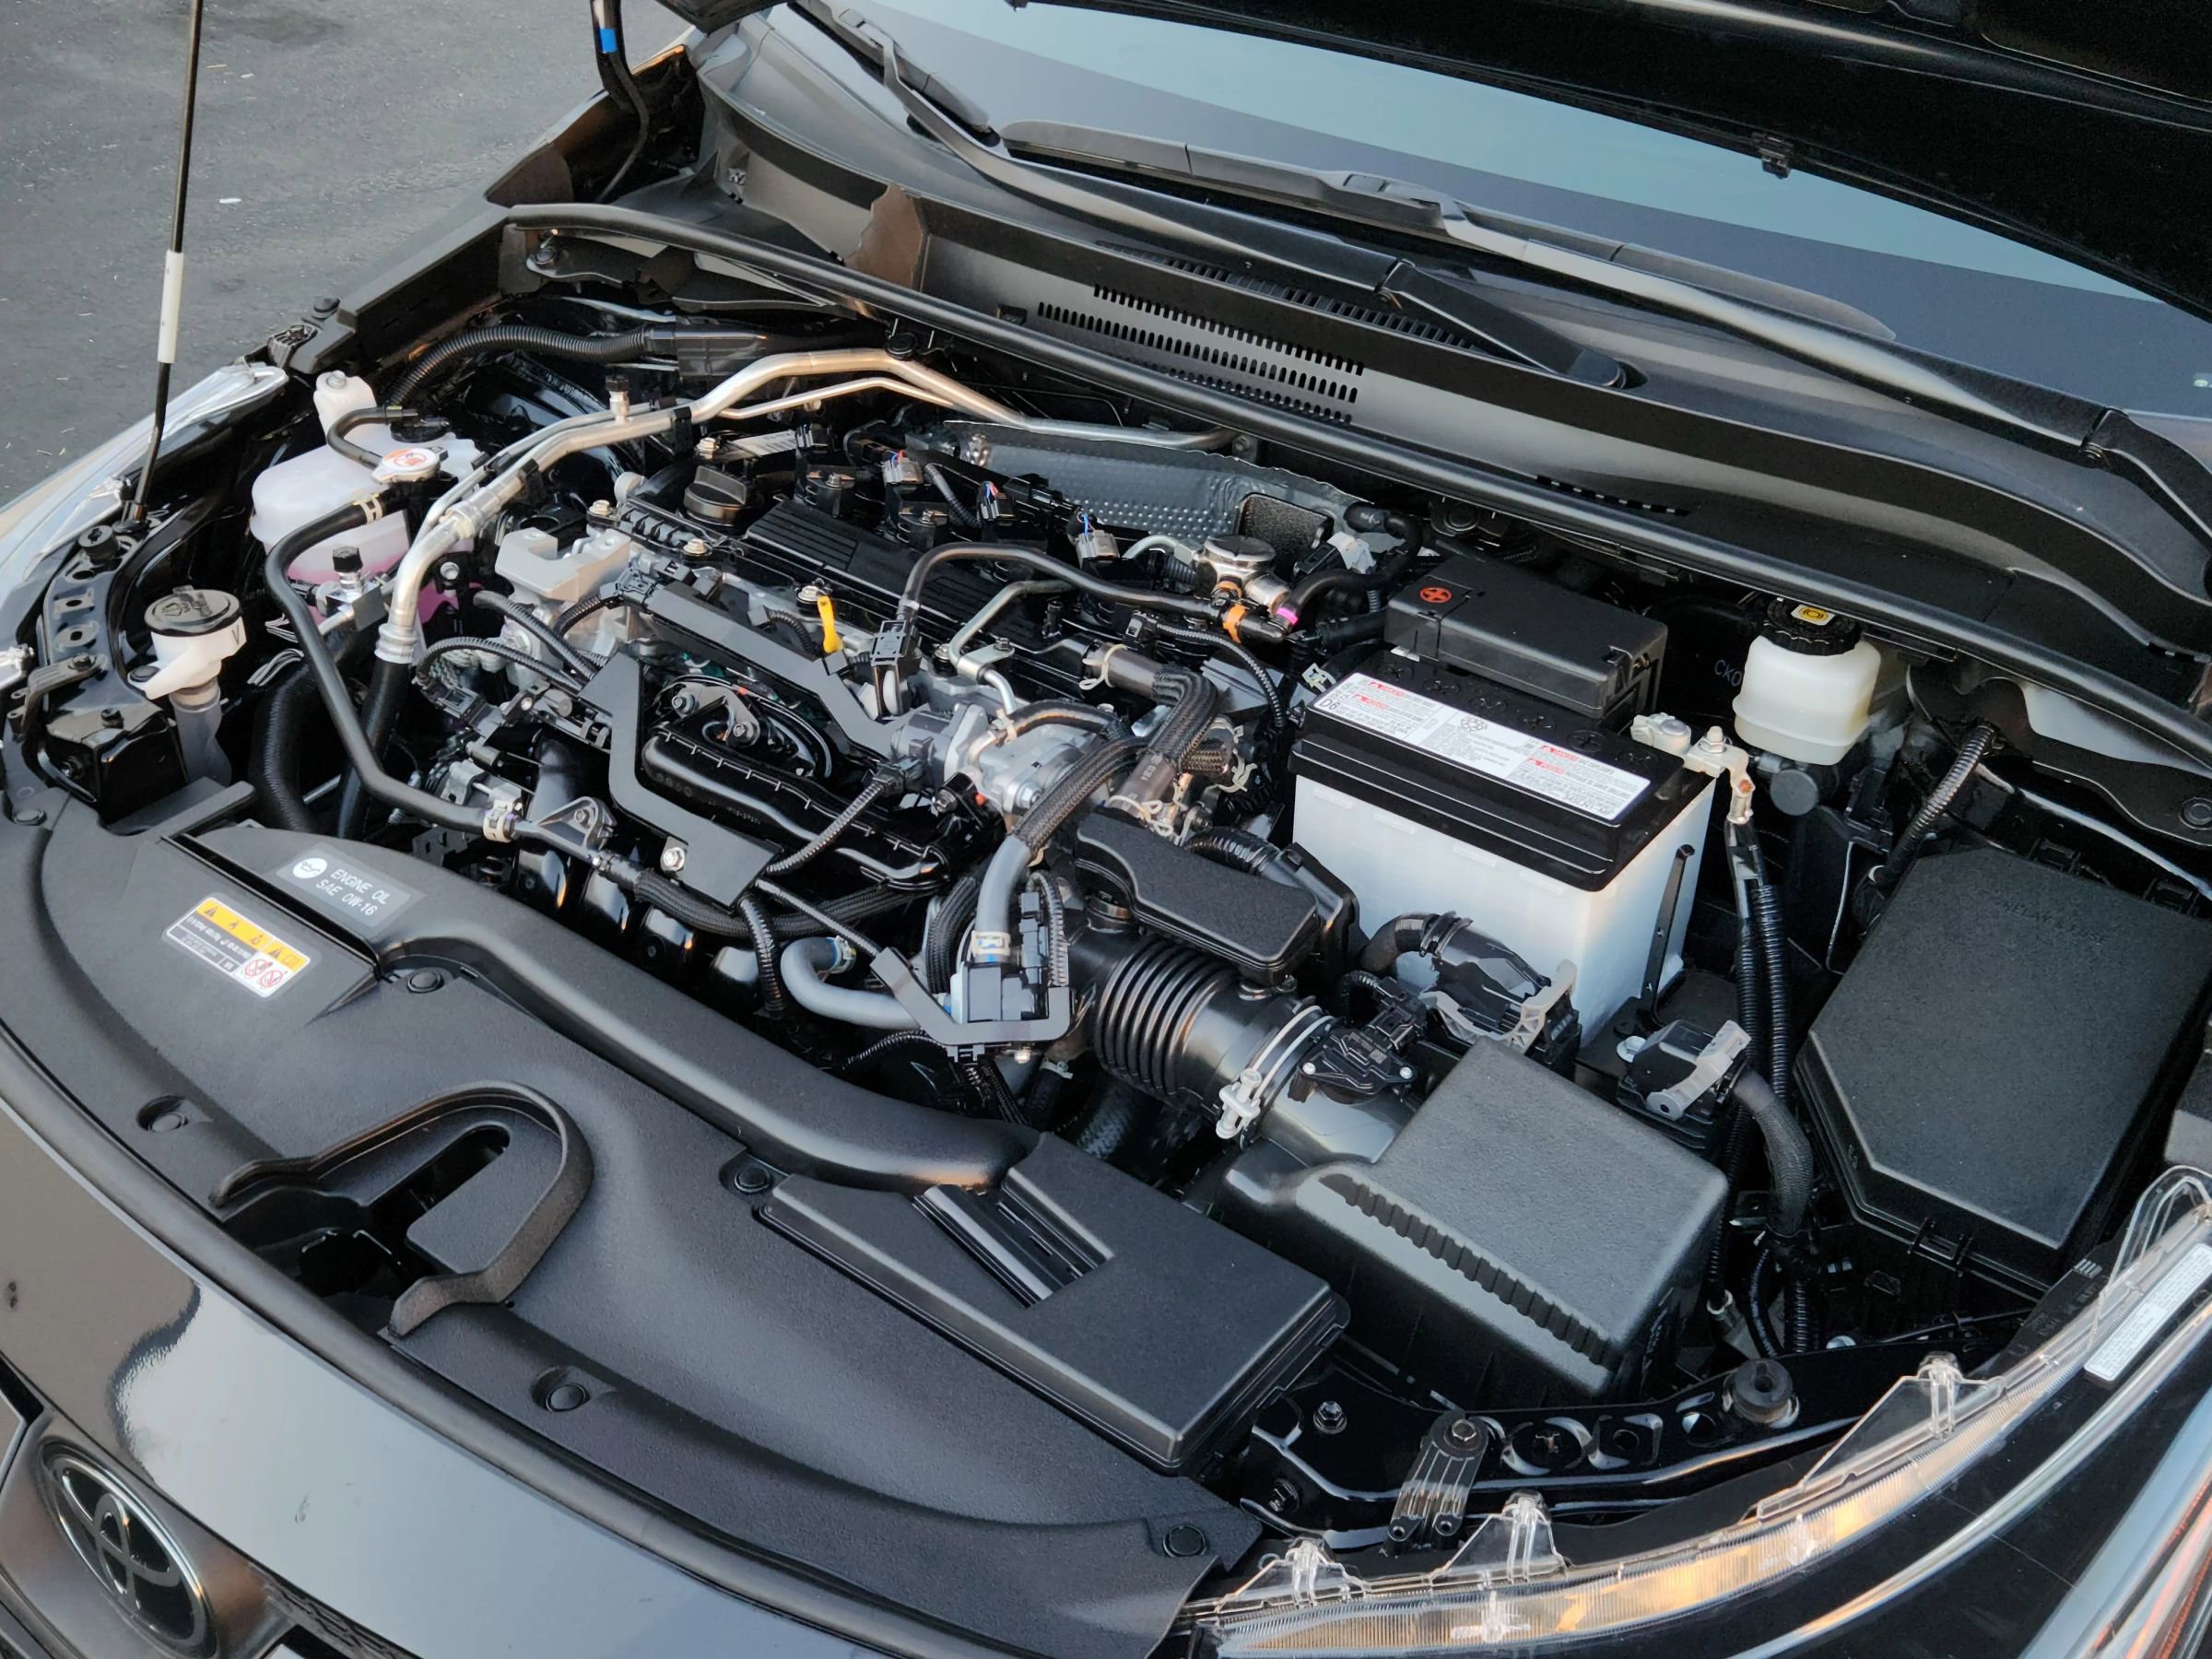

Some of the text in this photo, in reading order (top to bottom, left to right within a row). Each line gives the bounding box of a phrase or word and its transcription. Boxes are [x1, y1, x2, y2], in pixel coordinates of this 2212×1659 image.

[1319, 698, 1341, 711] D6
[316, 878, 378, 916] SAE 0W-16
[330, 868, 391, 905] ENGINE OIL
